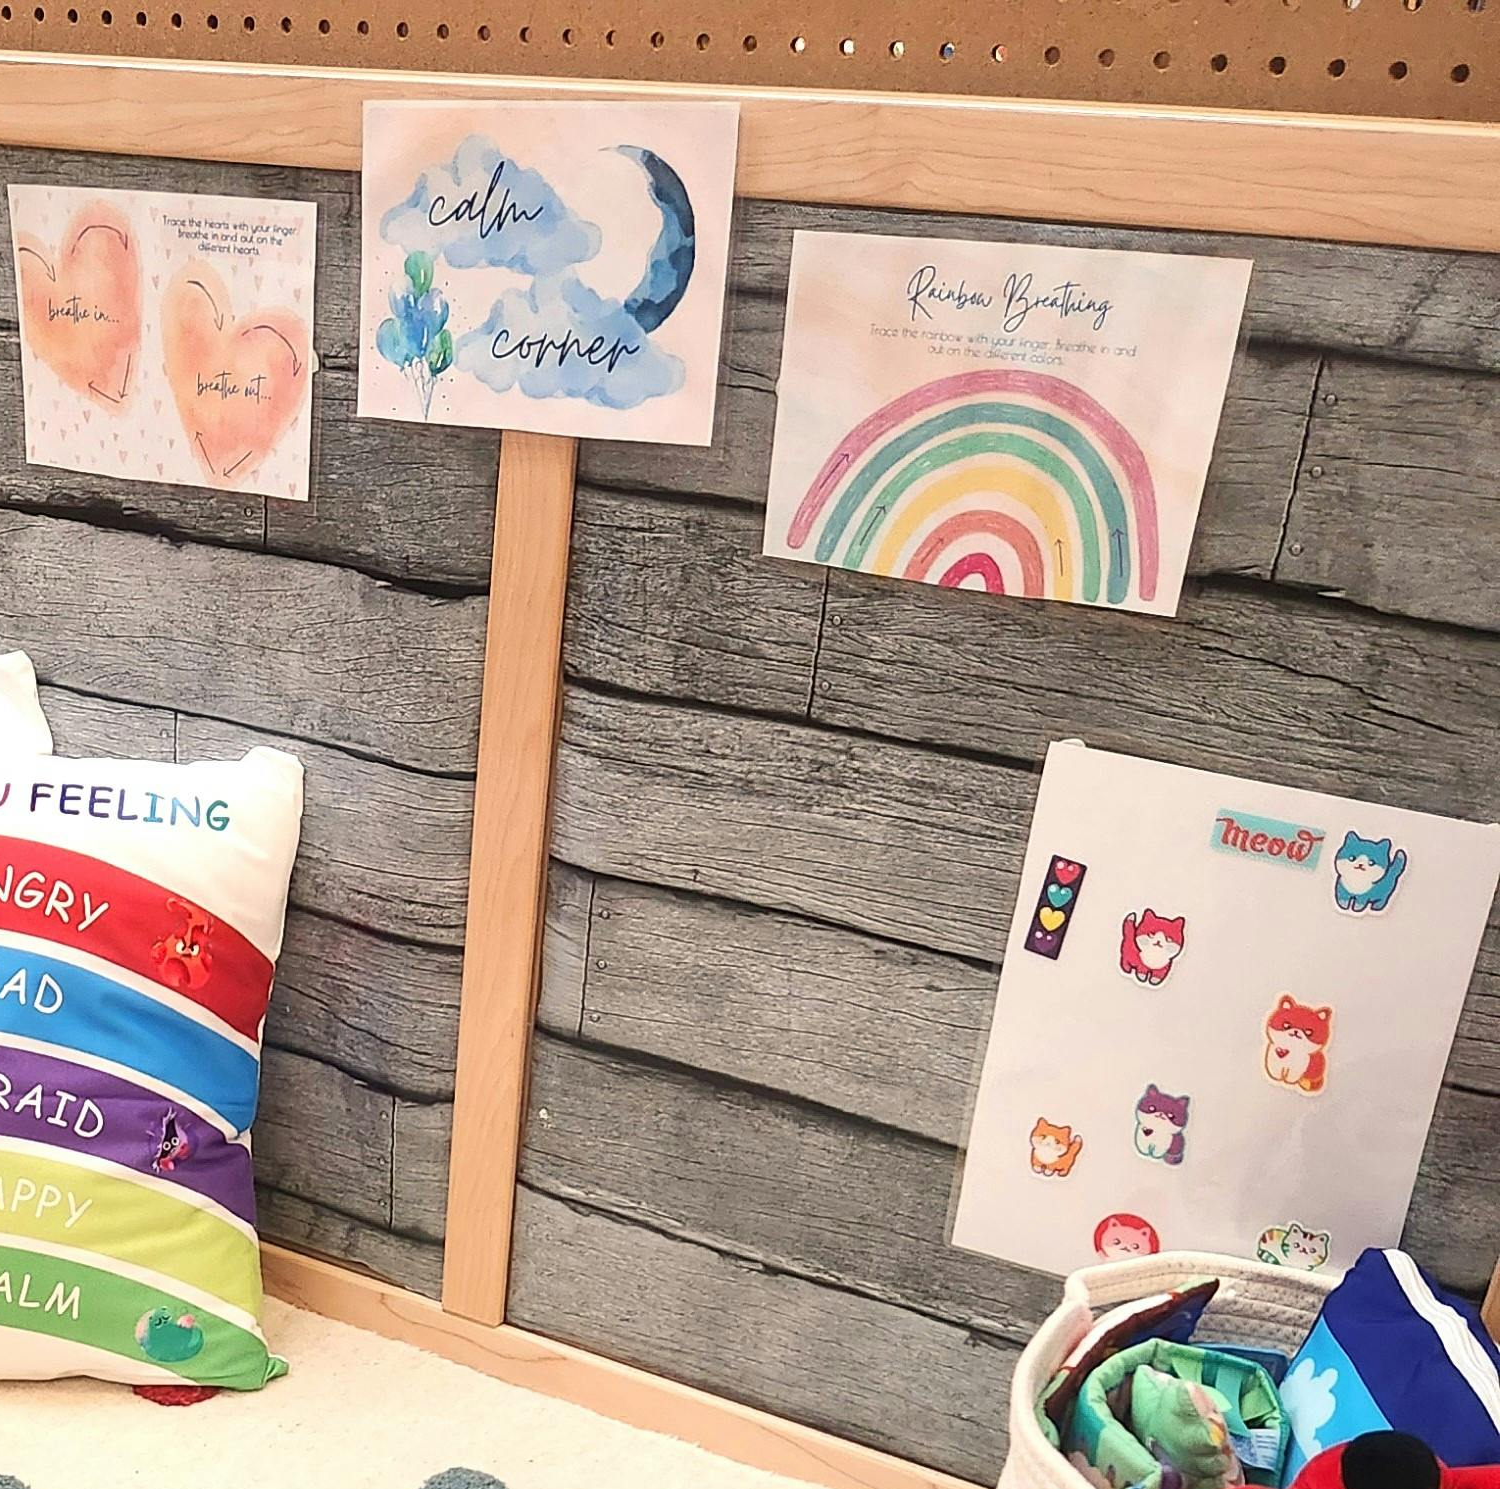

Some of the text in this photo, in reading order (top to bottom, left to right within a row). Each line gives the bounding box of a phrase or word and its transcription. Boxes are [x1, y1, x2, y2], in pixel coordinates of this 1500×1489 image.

[429, 161, 543, 239] calm
[188, 218, 202, 229] the
[204, 219, 230, 230] hearts
[250, 224, 270, 235] your
[211, 231, 220, 240] in
[221, 232, 238, 243] and
[240, 234, 255, 244] out
[256, 236, 268, 245] on
[269, 236, 283, 247] the
[197, 240, 231, 254] different
[48, 296, 90, 324] breathe
[907, 265, 1114, 333] Rainbow Breathing
[491, 329, 640, 373] corner
[902, 327, 918, 339] the
[922, 330, 963, 343] rainbow
[967, 333, 989, 344] with
[991, 336, 1015, 351] your
[1101, 345, 1110, 354] in
[1115, 345, 1138, 357] and
[928, 345, 944, 355] out
[947, 347, 961, 356] on
[964, 346, 981, 358] the
[984, 348, 1026, 361] different
[197, 370, 240, 400] breathe
[30, 783, 230, 831] FEELING
[1215, 817, 1325, 862] meow
